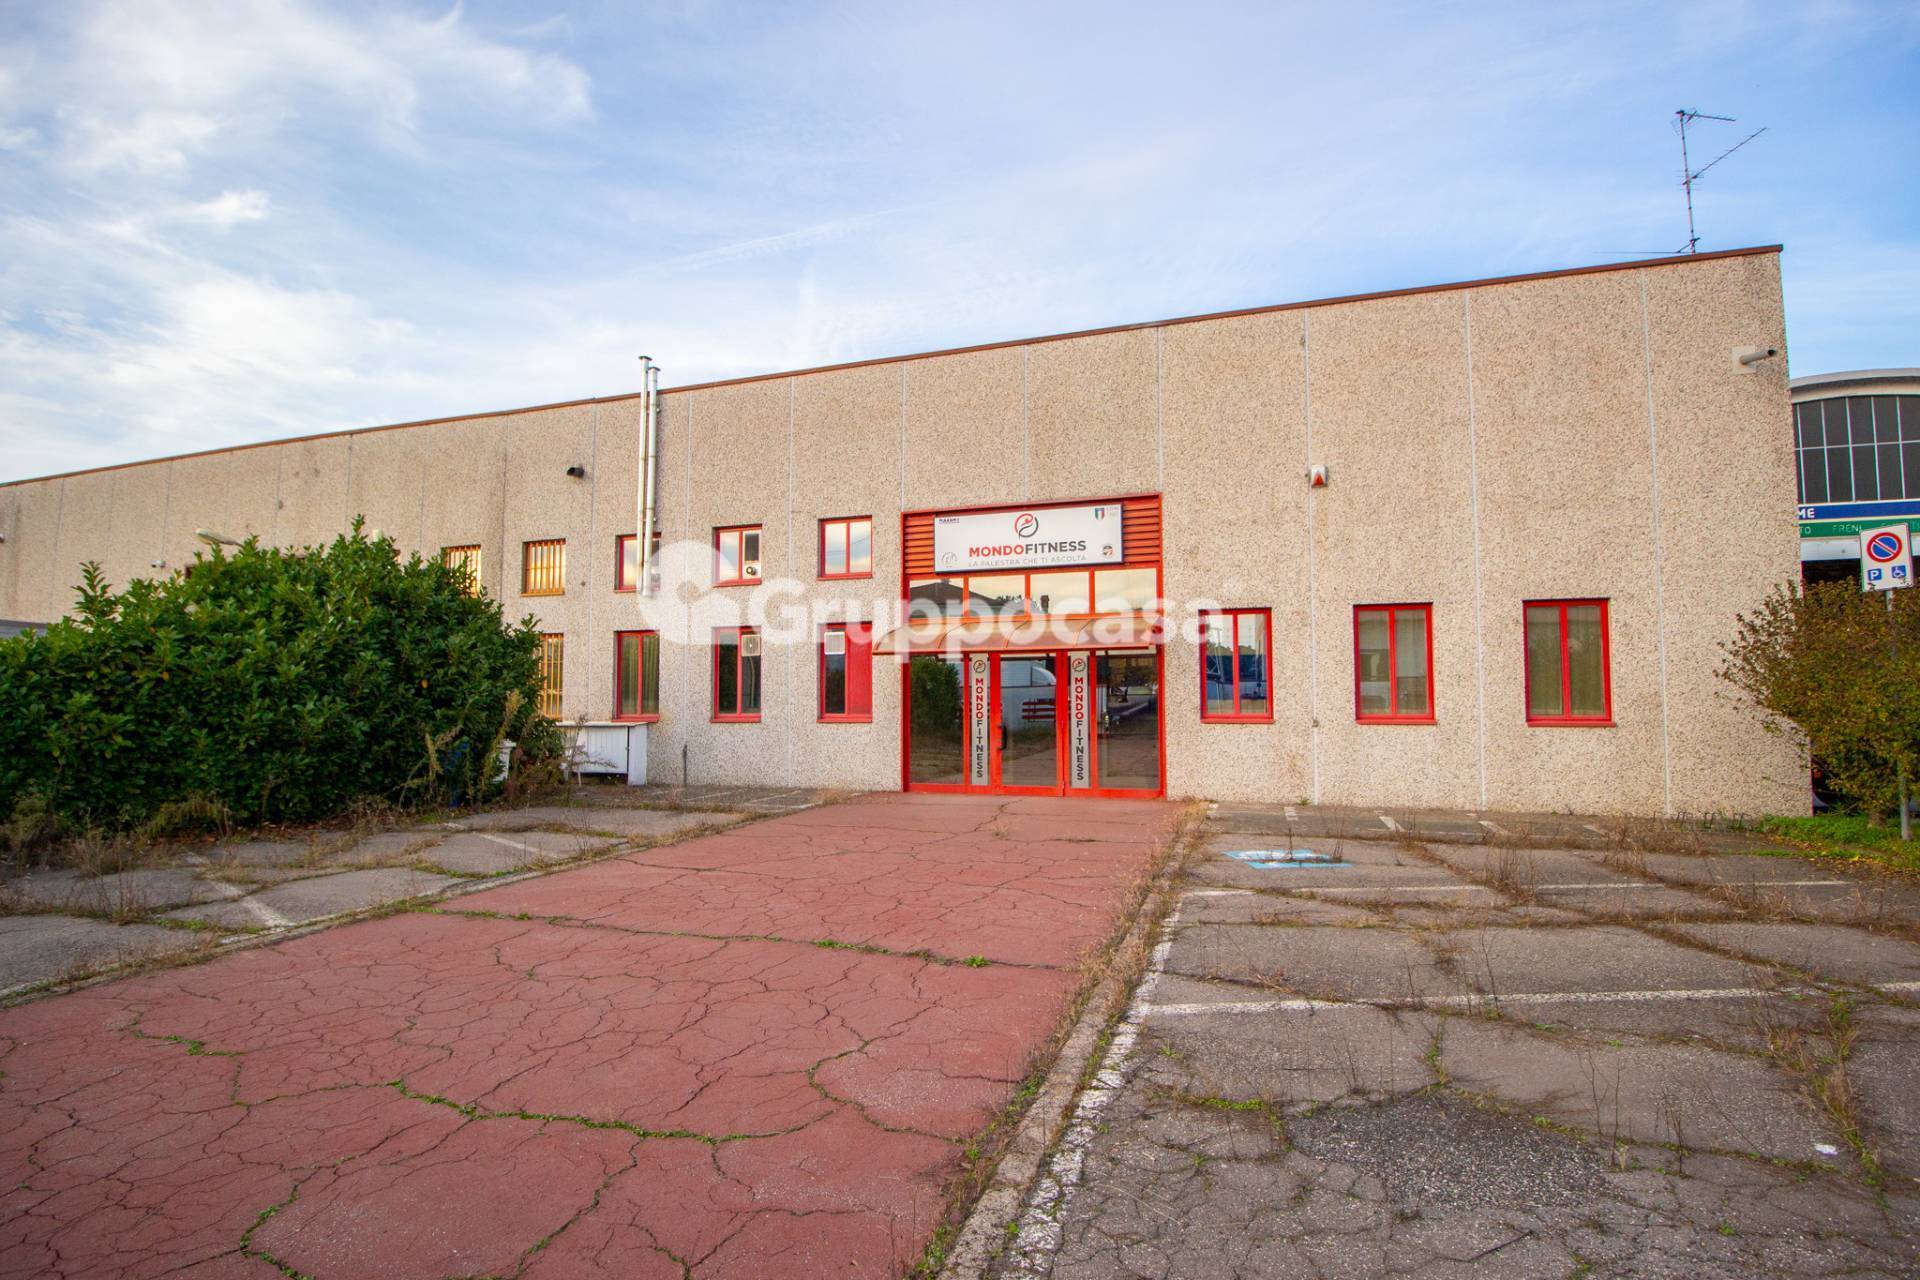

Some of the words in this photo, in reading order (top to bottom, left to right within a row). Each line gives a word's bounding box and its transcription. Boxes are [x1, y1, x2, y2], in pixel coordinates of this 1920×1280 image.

[969, 540, 1086, 557] MONDOFITNESS
[1870, 571, 1879, 580] P
[975, 678, 984, 778] MONDOFITNESS
[1074, 677, 1085, 781] MONDOFITNESS
